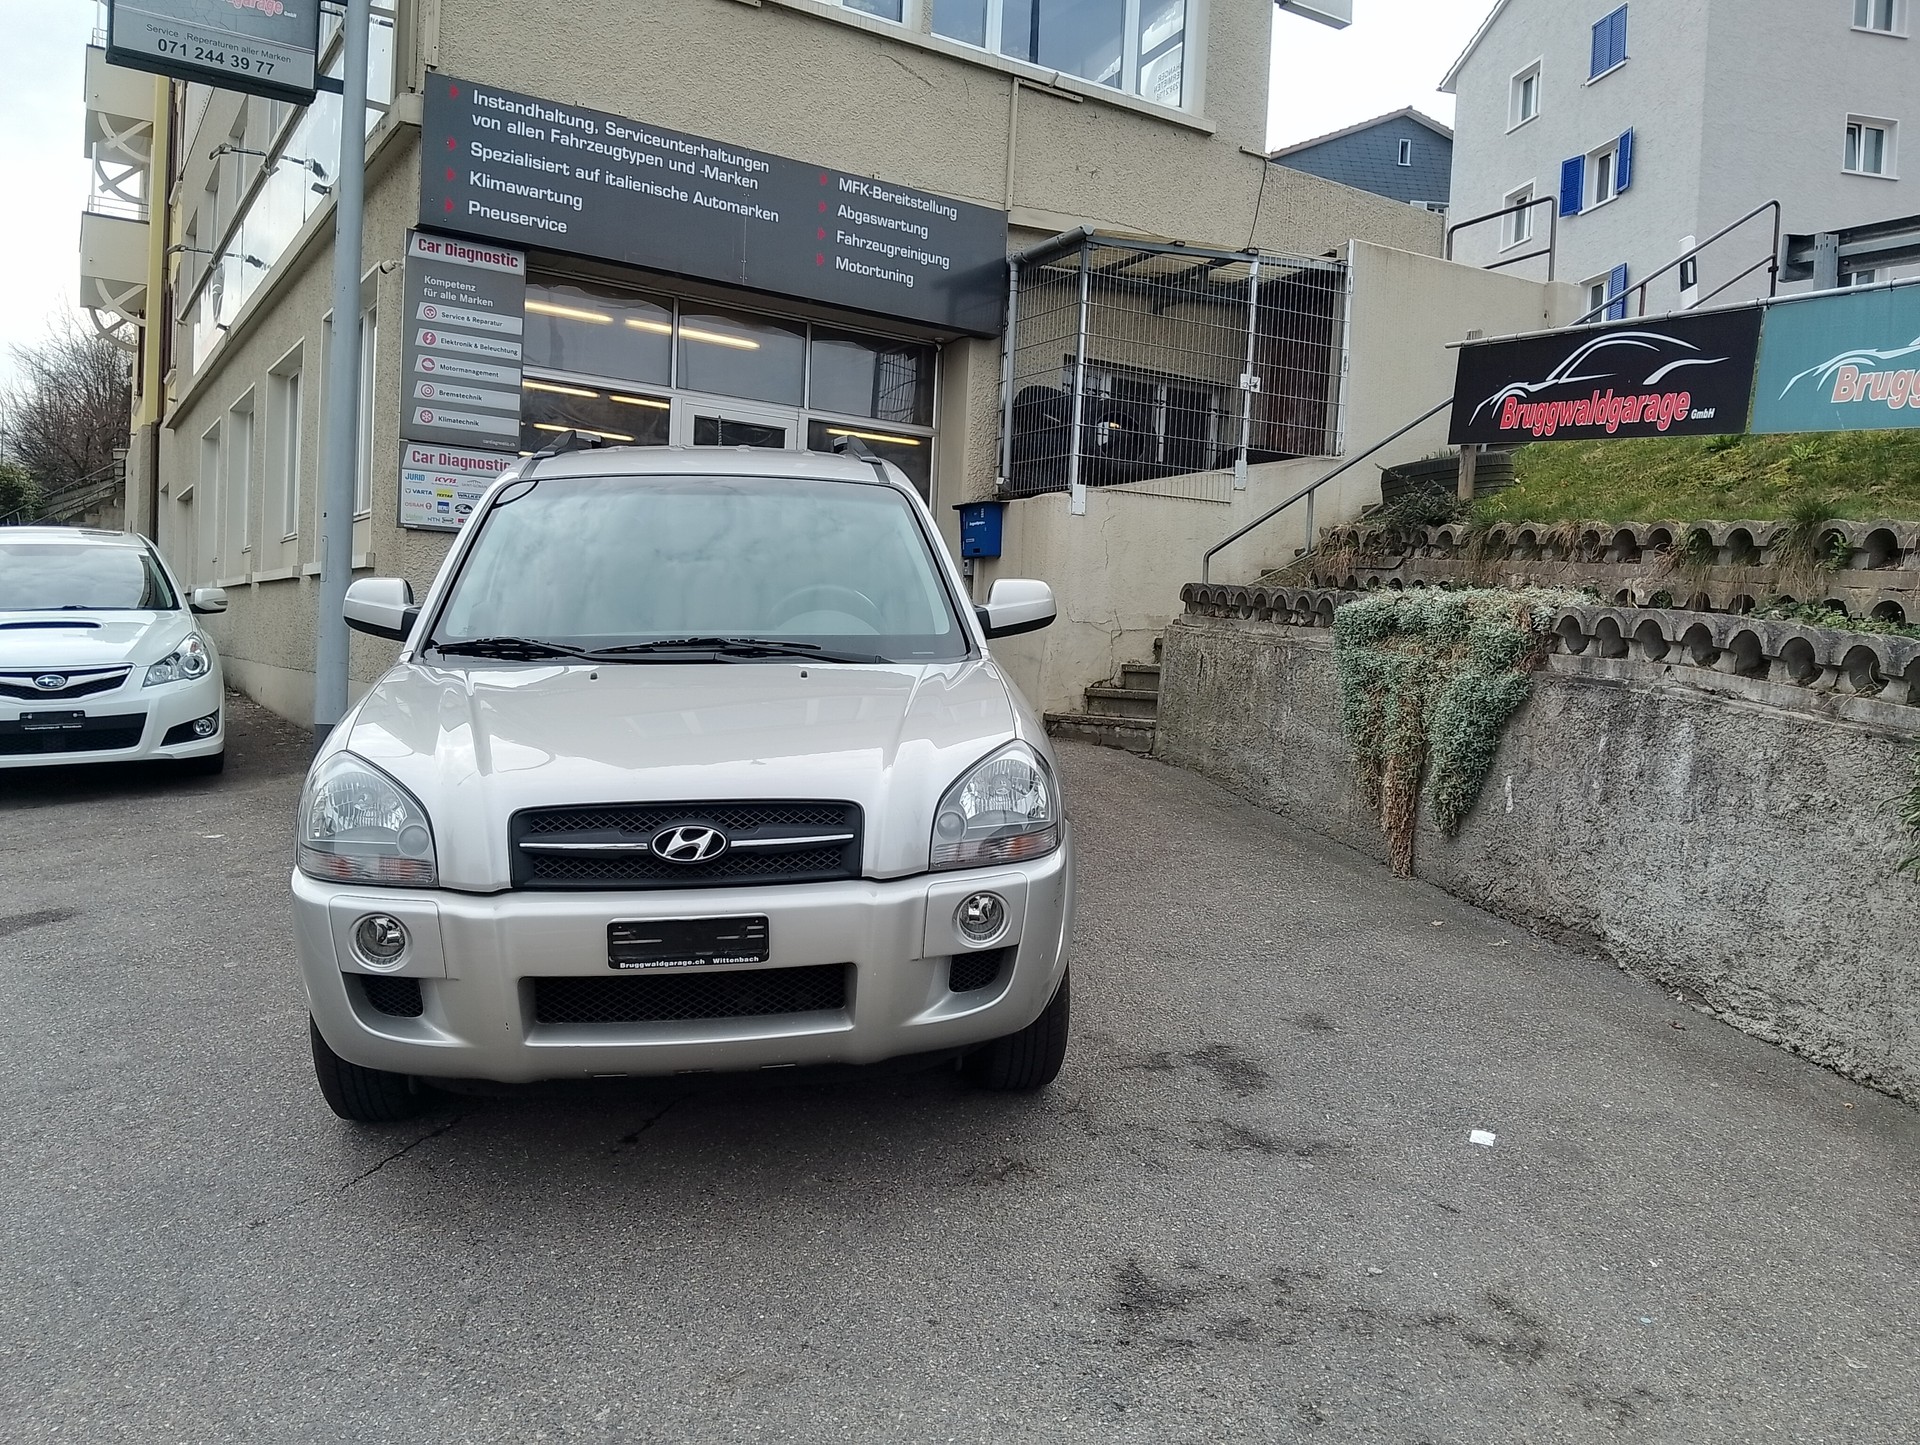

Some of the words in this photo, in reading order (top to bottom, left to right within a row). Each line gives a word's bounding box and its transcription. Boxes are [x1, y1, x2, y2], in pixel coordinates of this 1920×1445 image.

[146, 24, 179, 38] Service
[241, 46, 259, 56] aller
[261, 50, 291, 63] Marken
[158, 38, 187, 57] 071
[194, 46, 225, 65] 244
[230, 54, 250, 71] 39
[256, 60, 275, 75] 77
[473, 89, 600, 135] Instandhaltung,
[605, 121, 770, 174] Serviceunterhaltungen
[472, 114, 501, 131] von
[507, 120, 545, 141] allen
[550, 128, 664, 168] Fahrzeugtypen
[668, 158, 696, 175] und
[699, 165, 759, 190] -Marken
[469, 170, 584, 211] Klimawartung
[470, 141, 570, 176] Spezialisiert
[575, 166, 601, 183] auf
[605, 170, 689, 203] italienische
[692, 190, 780, 223] Automarken
[838, 177, 958, 221] MFK-Bereitstellung
[468, 200, 568, 234] Pneuservice
[837, 204, 929, 239] Abgaswartung
[418, 238, 442, 254] Car
[445, 243, 519, 268] Diagnostic
[836, 230, 950, 270] Fahrzeugreinigung
[424, 275, 476, 292] Kompetenz
[835, 256, 914, 288] Motortuning
[423, 287, 437, 298] für
[440, 290, 457, 301] alle
[459, 293, 494, 307] Marken
[441, 311, 465, 321] Service
[472, 316, 503, 328] Reparatur
[440, 338, 473, 349] Elektronik
[474, 341, 479, 349] &
[480, 343, 518, 356] Beleuchtung
[440, 363, 499, 378] Motormanagement
[439, 389, 483, 402] Bremstechnik
[438, 416, 480, 427] Klimatechnik
[1500, 389, 1690, 436] Bruggwaldgarage
[1690, 407, 1715, 420] GmbH
[412, 450, 435, 464] Car
[405, 472, 426, 482] JURID
[620, 959, 705, 968] Bruggwaldgarage.ch
[712, 956, 759, 964] Wittenbach
